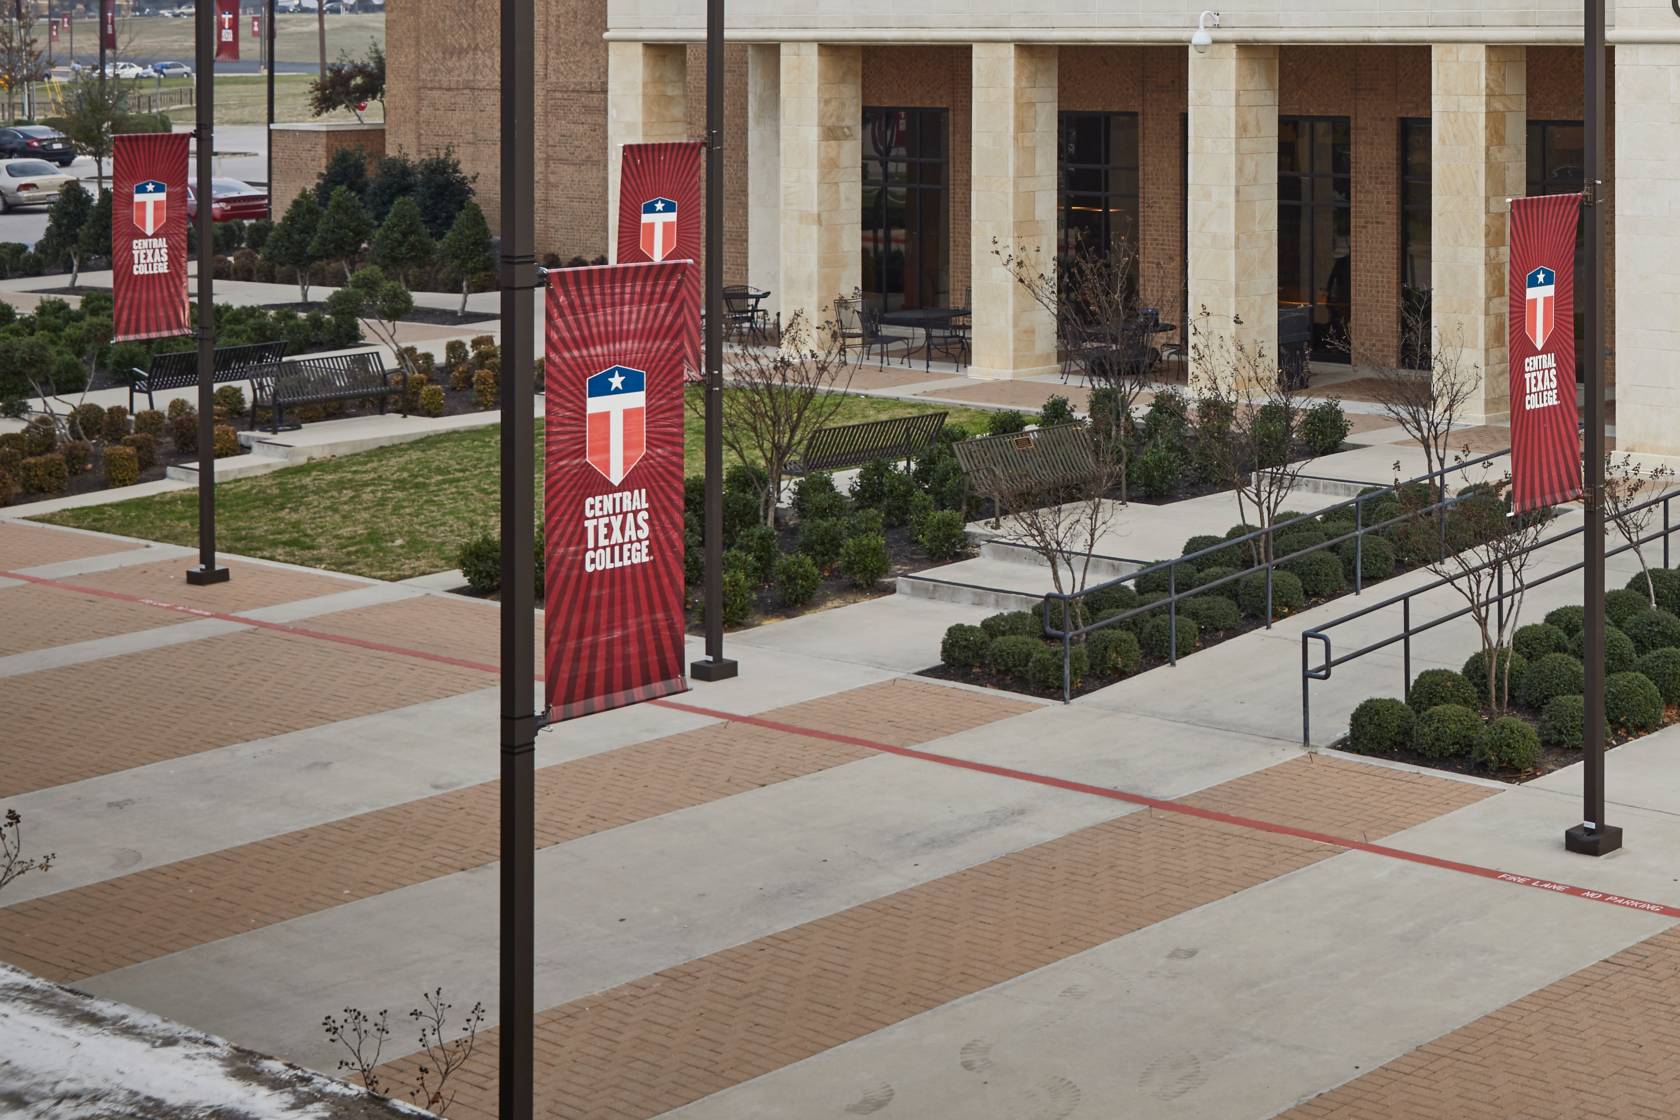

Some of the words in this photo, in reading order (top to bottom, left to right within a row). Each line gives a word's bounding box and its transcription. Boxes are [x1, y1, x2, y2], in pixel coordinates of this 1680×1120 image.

[133, 237, 168, 250] CENTRAL
[132, 248, 169, 265] TEXAS
[1525, 353, 1556, 371] CENTRAL
[1525, 368, 1557, 393] TEXAS
[585, 488, 649, 518] CENTRAL
[584, 510, 650, 549] TEXAS
[1497, 873, 1530, 884] FIRE
[1531, 879, 1570, 892] LANE
[1580, 890, 1603, 899] NO
[1605, 896, 1663, 912] PARKING
